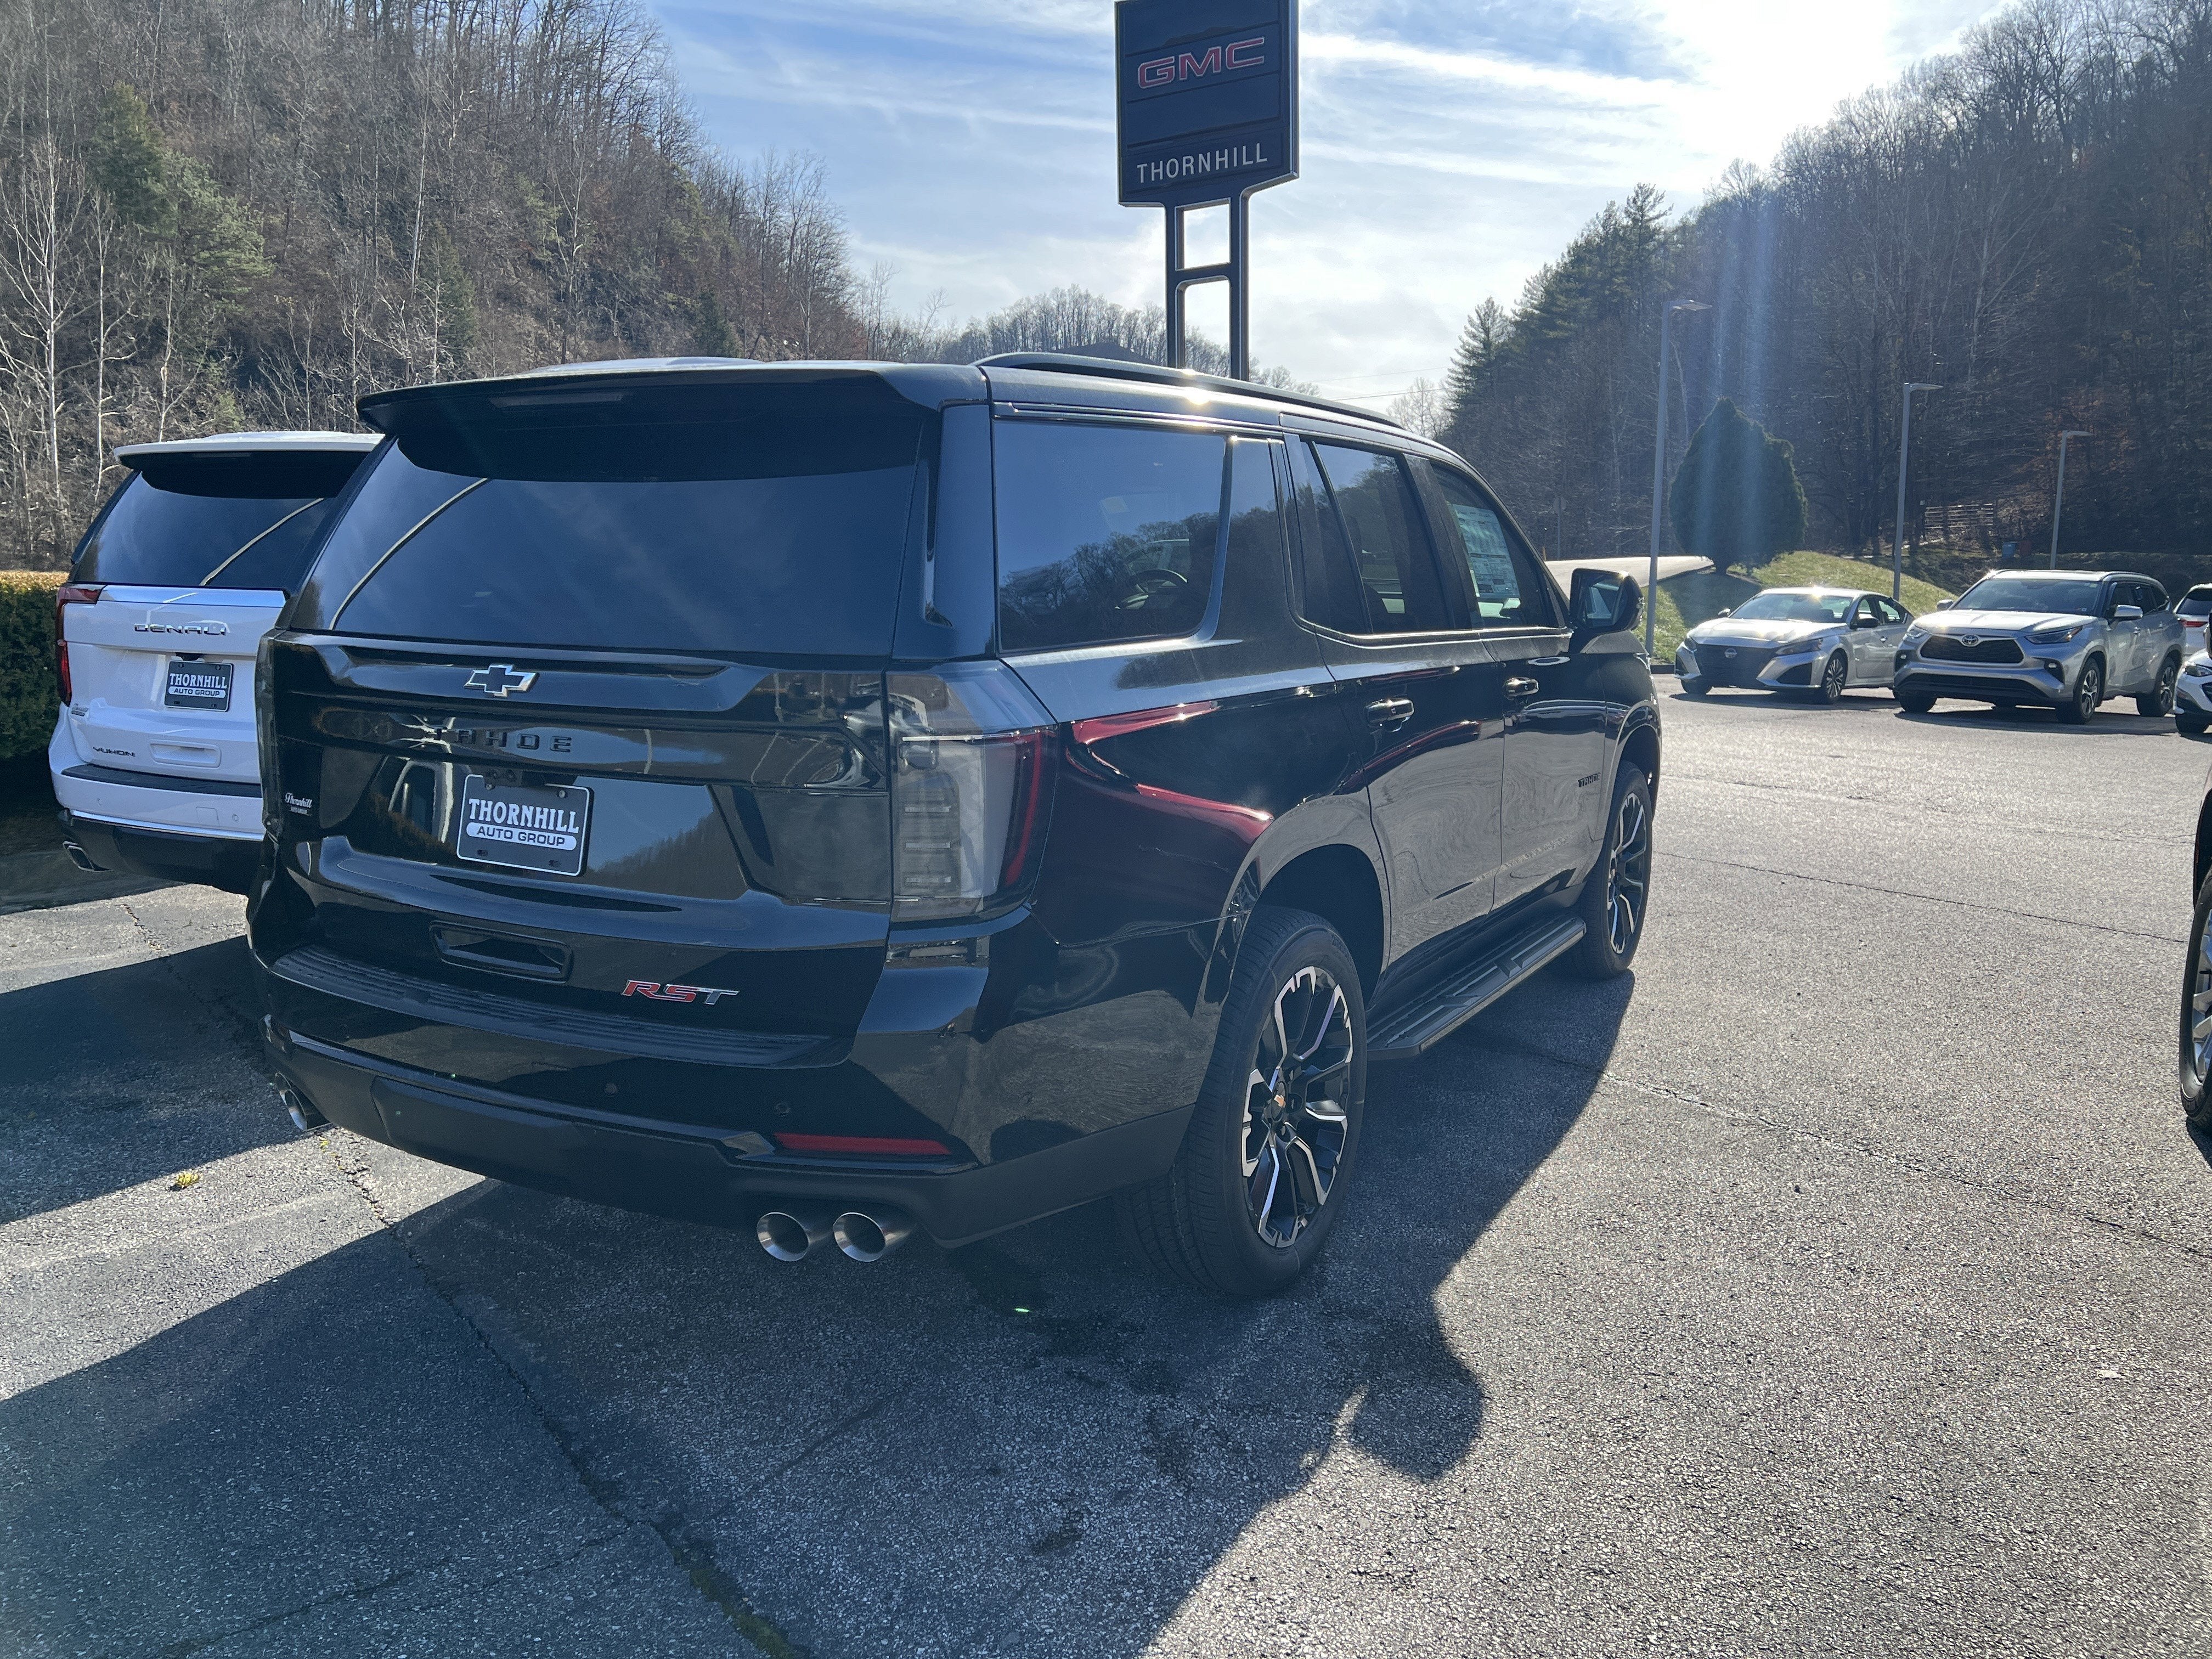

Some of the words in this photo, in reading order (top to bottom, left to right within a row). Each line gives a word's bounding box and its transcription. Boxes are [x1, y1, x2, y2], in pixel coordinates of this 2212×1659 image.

[1138, 37, 1265, 89] GMC
[1137, 143, 1267, 183] THORNHILL
[133, 623, 227, 635] DENALI
[170, 673, 227, 689] THORNHILL
[93, 747, 136, 757] YUKON
[469, 798, 579, 833] THORNHILL
[477, 826, 514, 839] AUTO
[518, 832, 565, 846] GROUP
[621, 979, 740, 1005] RST
